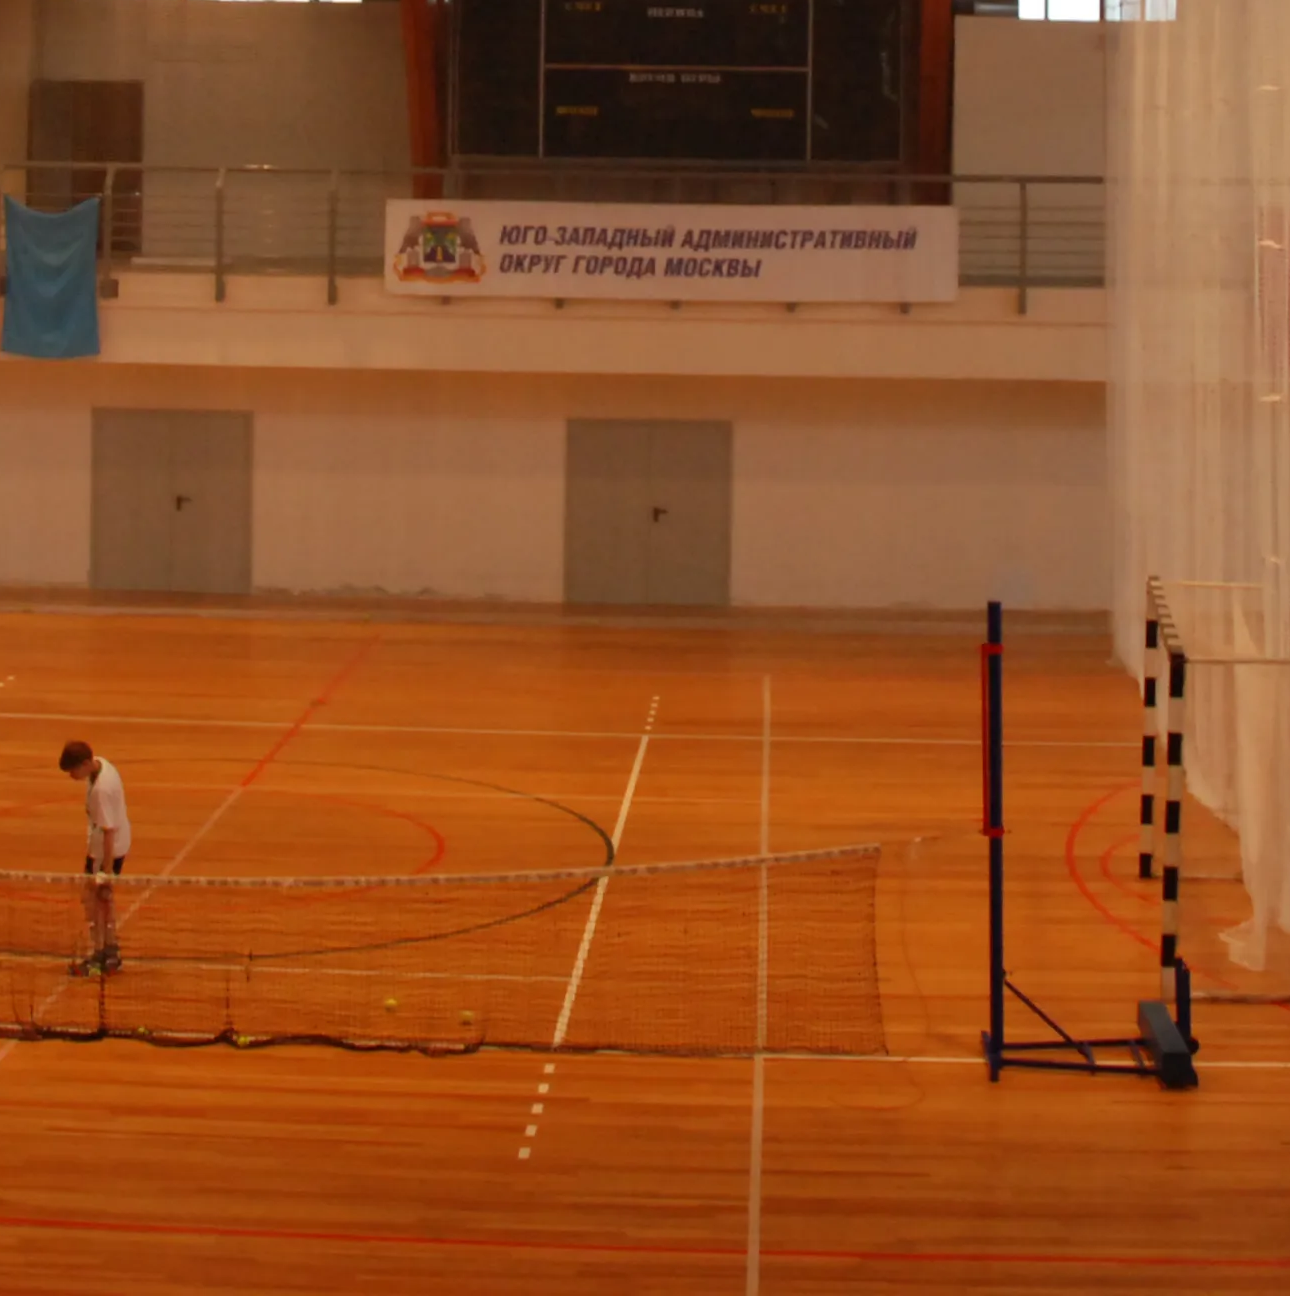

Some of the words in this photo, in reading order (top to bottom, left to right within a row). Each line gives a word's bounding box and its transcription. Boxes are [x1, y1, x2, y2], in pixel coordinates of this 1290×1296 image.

[500, 225, 675, 250] ЮГО-ЗАПАДНЫЙ
[681, 226, 917, 252] АДМИНИСТРАТИВНЫЙ
[499, 254, 567, 273] ОКРУГ
[572, 255, 656, 278] ГОРОДА
[664, 257, 762, 278] МОСКВЫ
